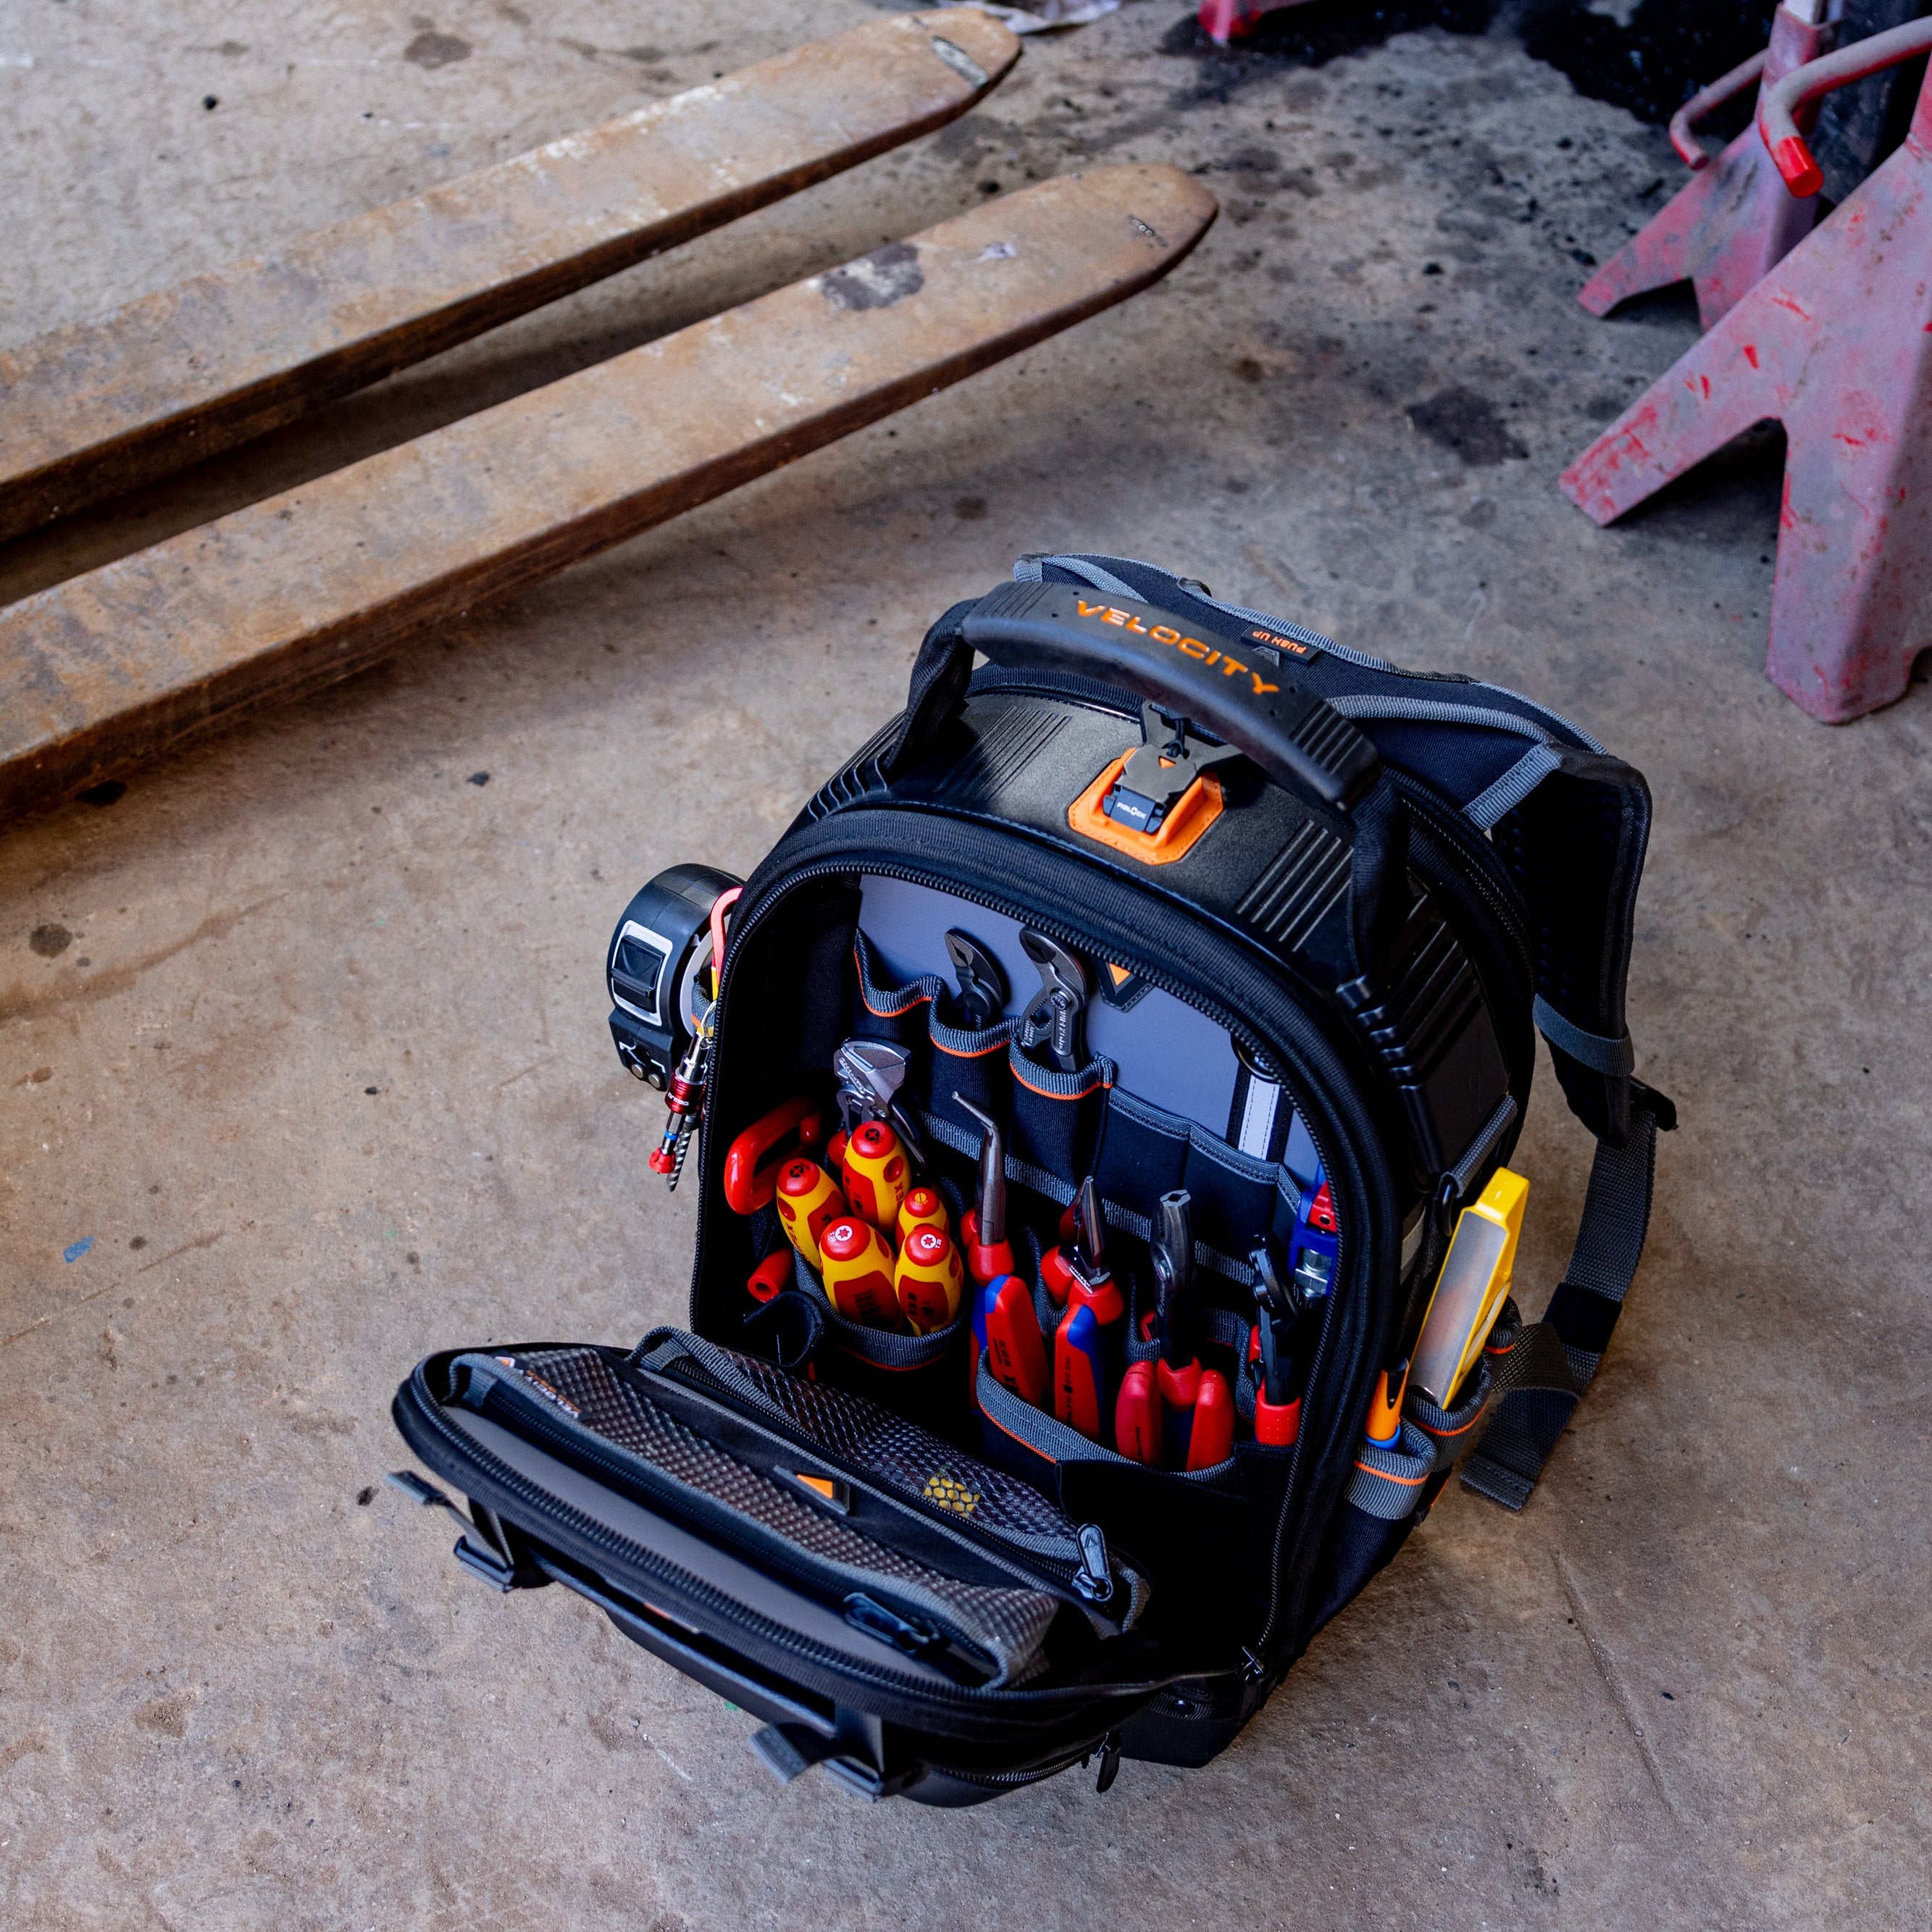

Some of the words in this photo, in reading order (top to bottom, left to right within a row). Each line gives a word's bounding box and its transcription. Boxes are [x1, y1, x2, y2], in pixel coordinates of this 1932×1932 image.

[1253, 630, 1271, 642] UP
[1271, 636, 1307, 654] PUSH
[1077, 599, 1280, 695] VELOCITY
